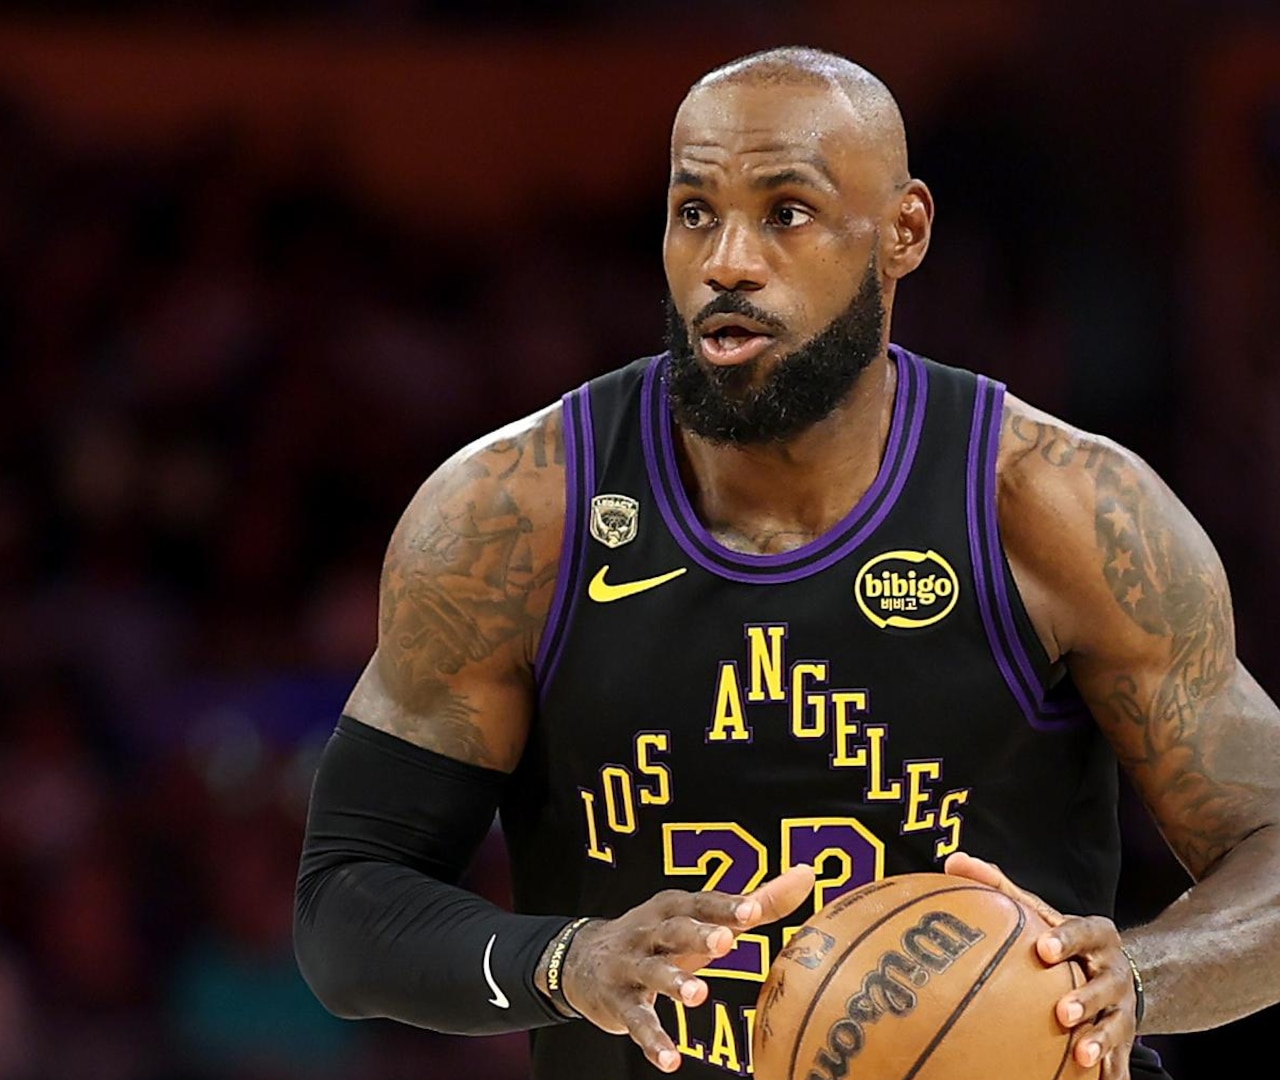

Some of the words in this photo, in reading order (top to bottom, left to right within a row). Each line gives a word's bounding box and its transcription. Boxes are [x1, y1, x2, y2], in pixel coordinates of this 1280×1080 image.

[865, 570, 952, 605] bibigo
[881, 598, 918, 611] 비비고
[580, 734, 671, 863] LOS
[707, 624, 969, 859] ANGELES
[548, 942, 566, 990] AKRON
